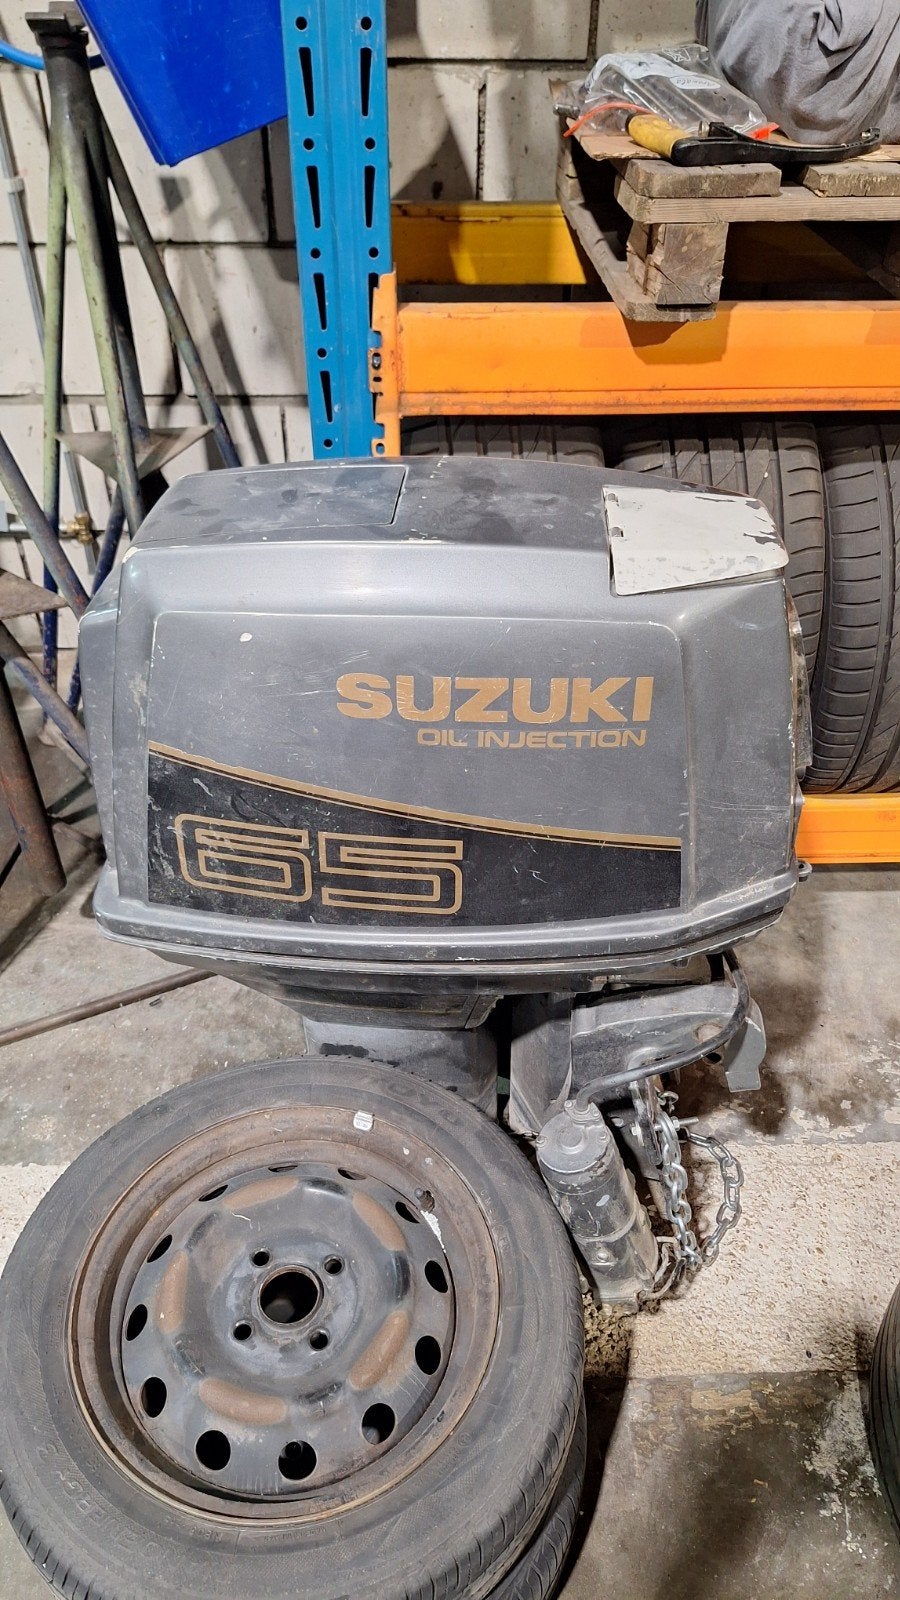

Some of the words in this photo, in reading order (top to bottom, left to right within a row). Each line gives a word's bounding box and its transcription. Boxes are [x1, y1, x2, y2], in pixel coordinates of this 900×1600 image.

[336, 672, 654, 724] SUZUKI
[417, 727, 468, 747] OIL
[477, 728, 647, 749] INJECTION
[174, 813, 464, 915] 65
